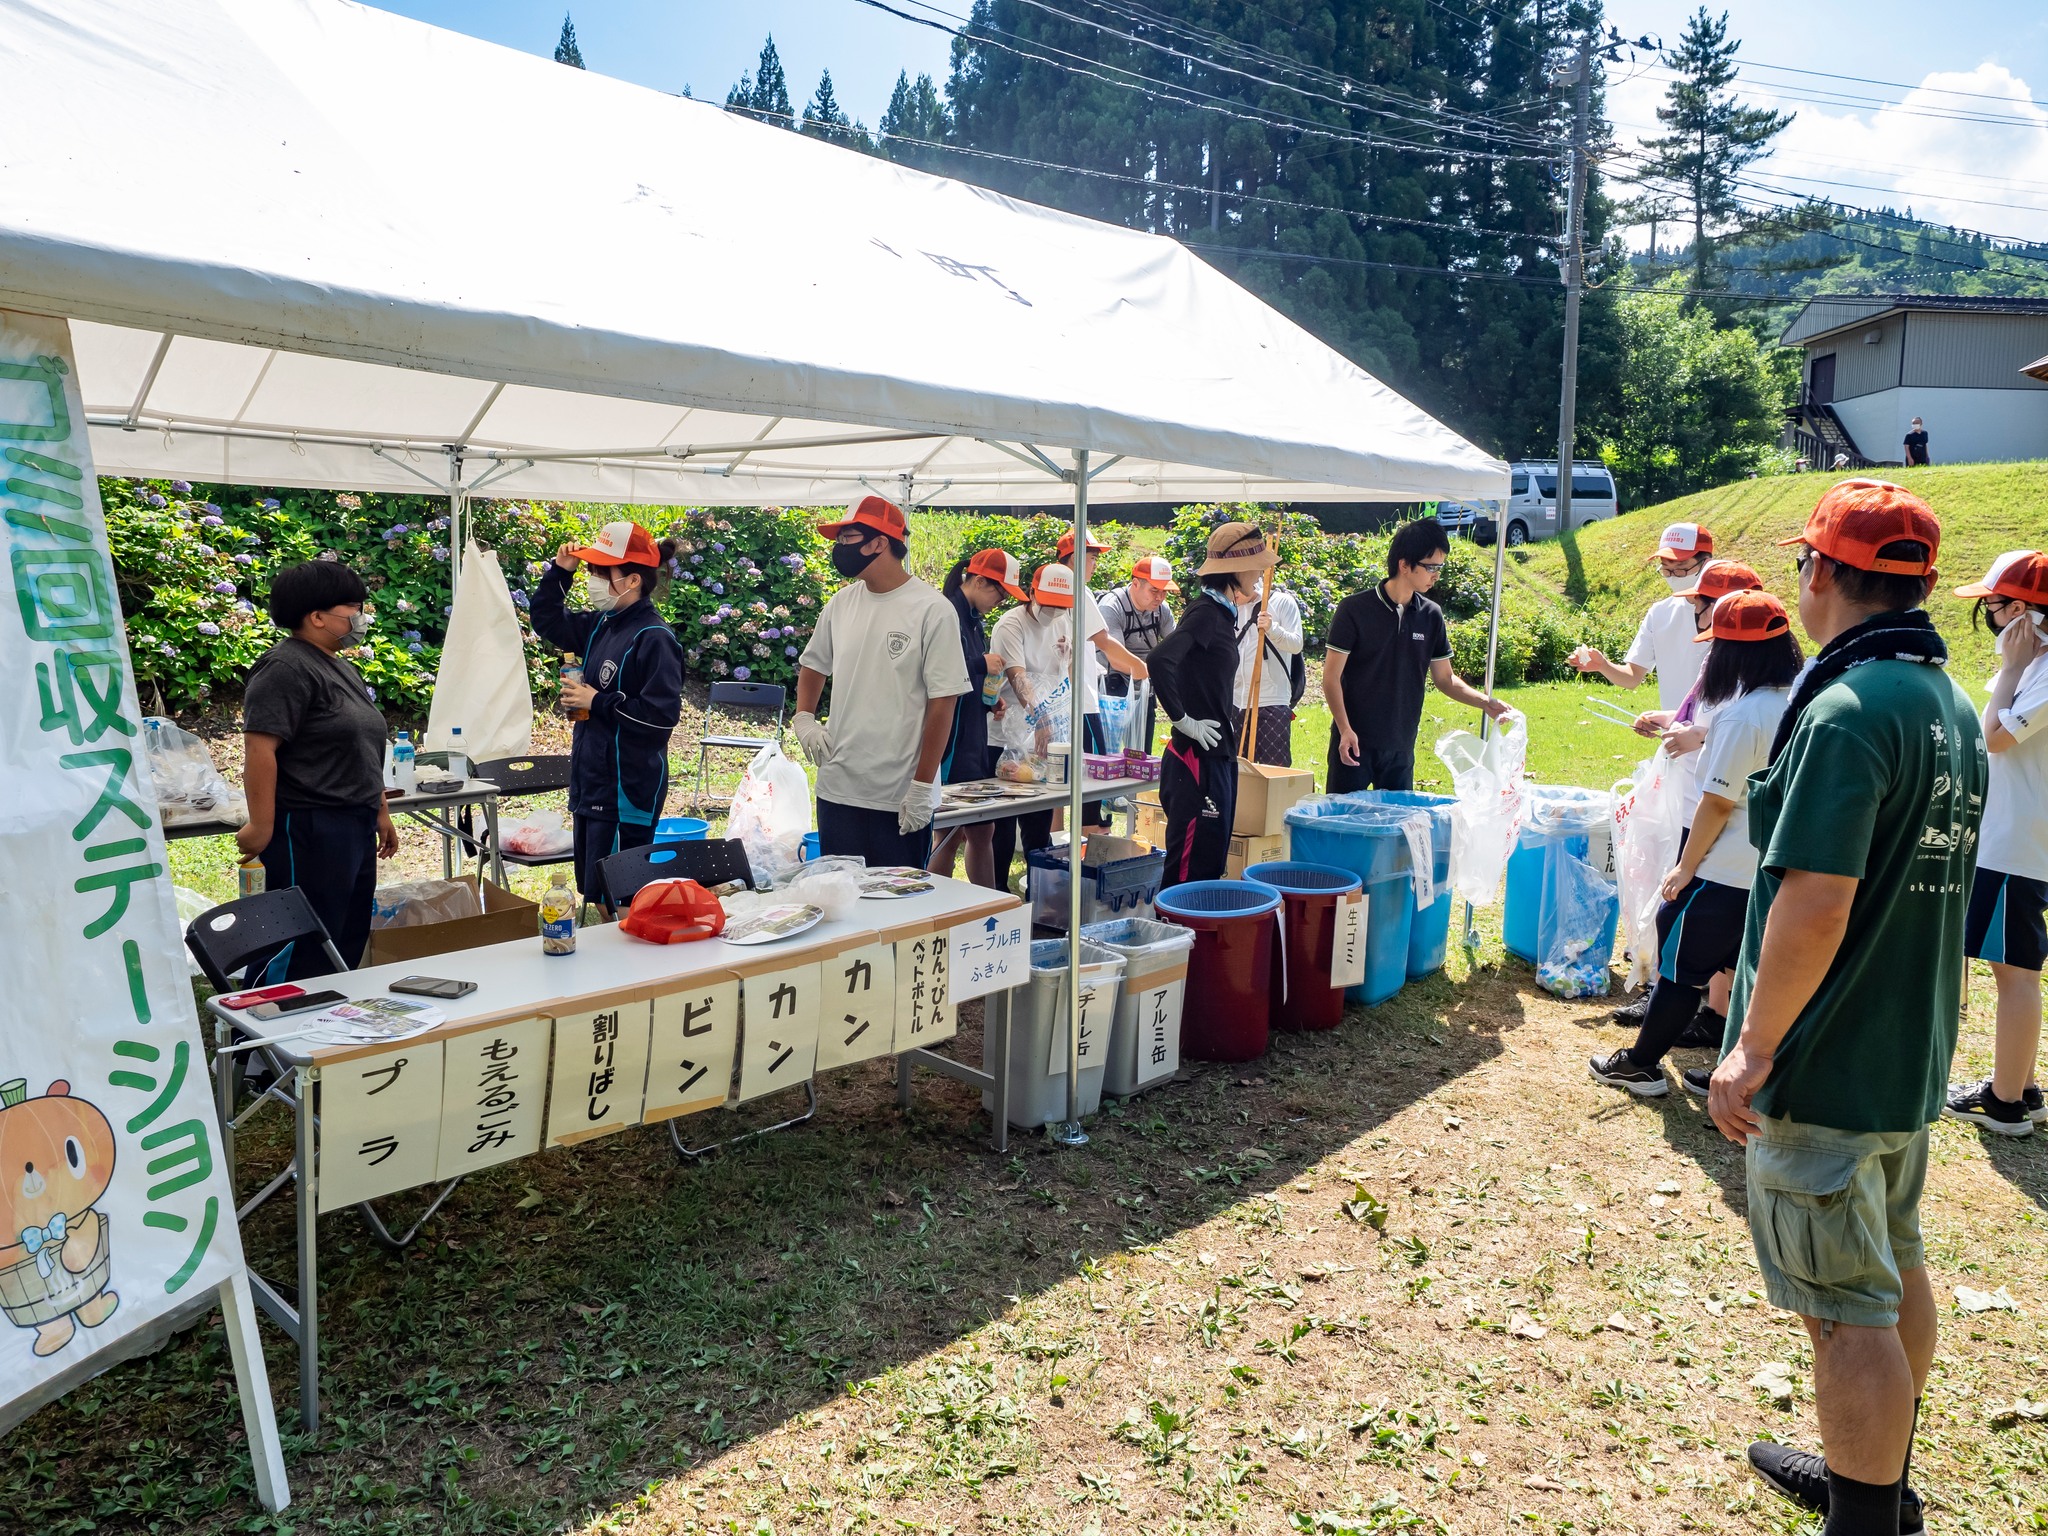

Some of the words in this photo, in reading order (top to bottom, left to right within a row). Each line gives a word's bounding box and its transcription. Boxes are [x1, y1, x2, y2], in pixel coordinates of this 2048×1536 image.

[0, 355, 219, 1295] ゴミ回収ステーション
[959, 928, 1022, 956] テーブル用
[970, 962, 1008, 983] ふきん
[1347, 907, 1358, 965] 生ゴミ
[768, 983, 797, 1074] カン
[843, 959, 871, 1047] カン
[910, 939, 925, 1034] ペットボトル
[1151, 989, 1168, 1066] アルミ缶
[586, 1009, 619, 1121] 割りばし
[678, 996, 714, 1094] ビン
[358, 1057, 409, 1167] プラ
[467, 1038, 520, 1154] もえるごみ
